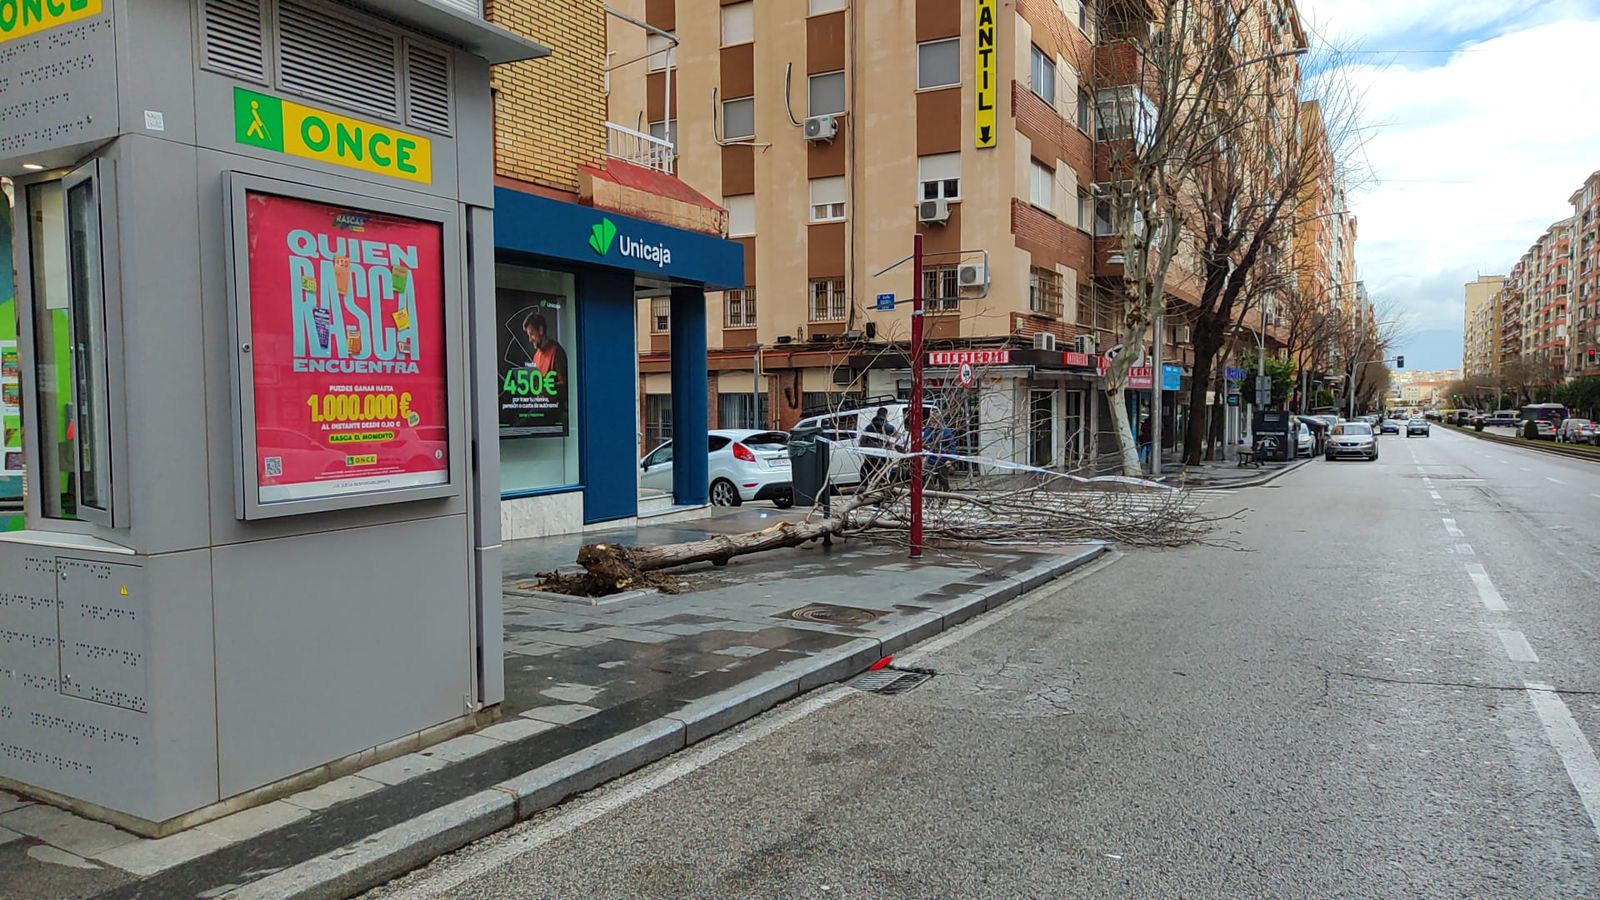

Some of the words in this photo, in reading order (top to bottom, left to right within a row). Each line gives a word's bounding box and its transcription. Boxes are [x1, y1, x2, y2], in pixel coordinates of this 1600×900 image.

[978, 0, 993, 111] ANTIL
[301, 116, 417, 174] ONCE
[287, 229, 419, 269] QUIEN
[619, 235, 671, 268] Unicaja
[289, 255, 420, 361] RASCA
[293, 358, 421, 374] ENCUENTRA
[503, 369, 559, 396] 450€
[330, 434, 353, 442] RASCA
[354, 433, 361, 441] EL
[362, 432, 393, 440] MOMENTO
